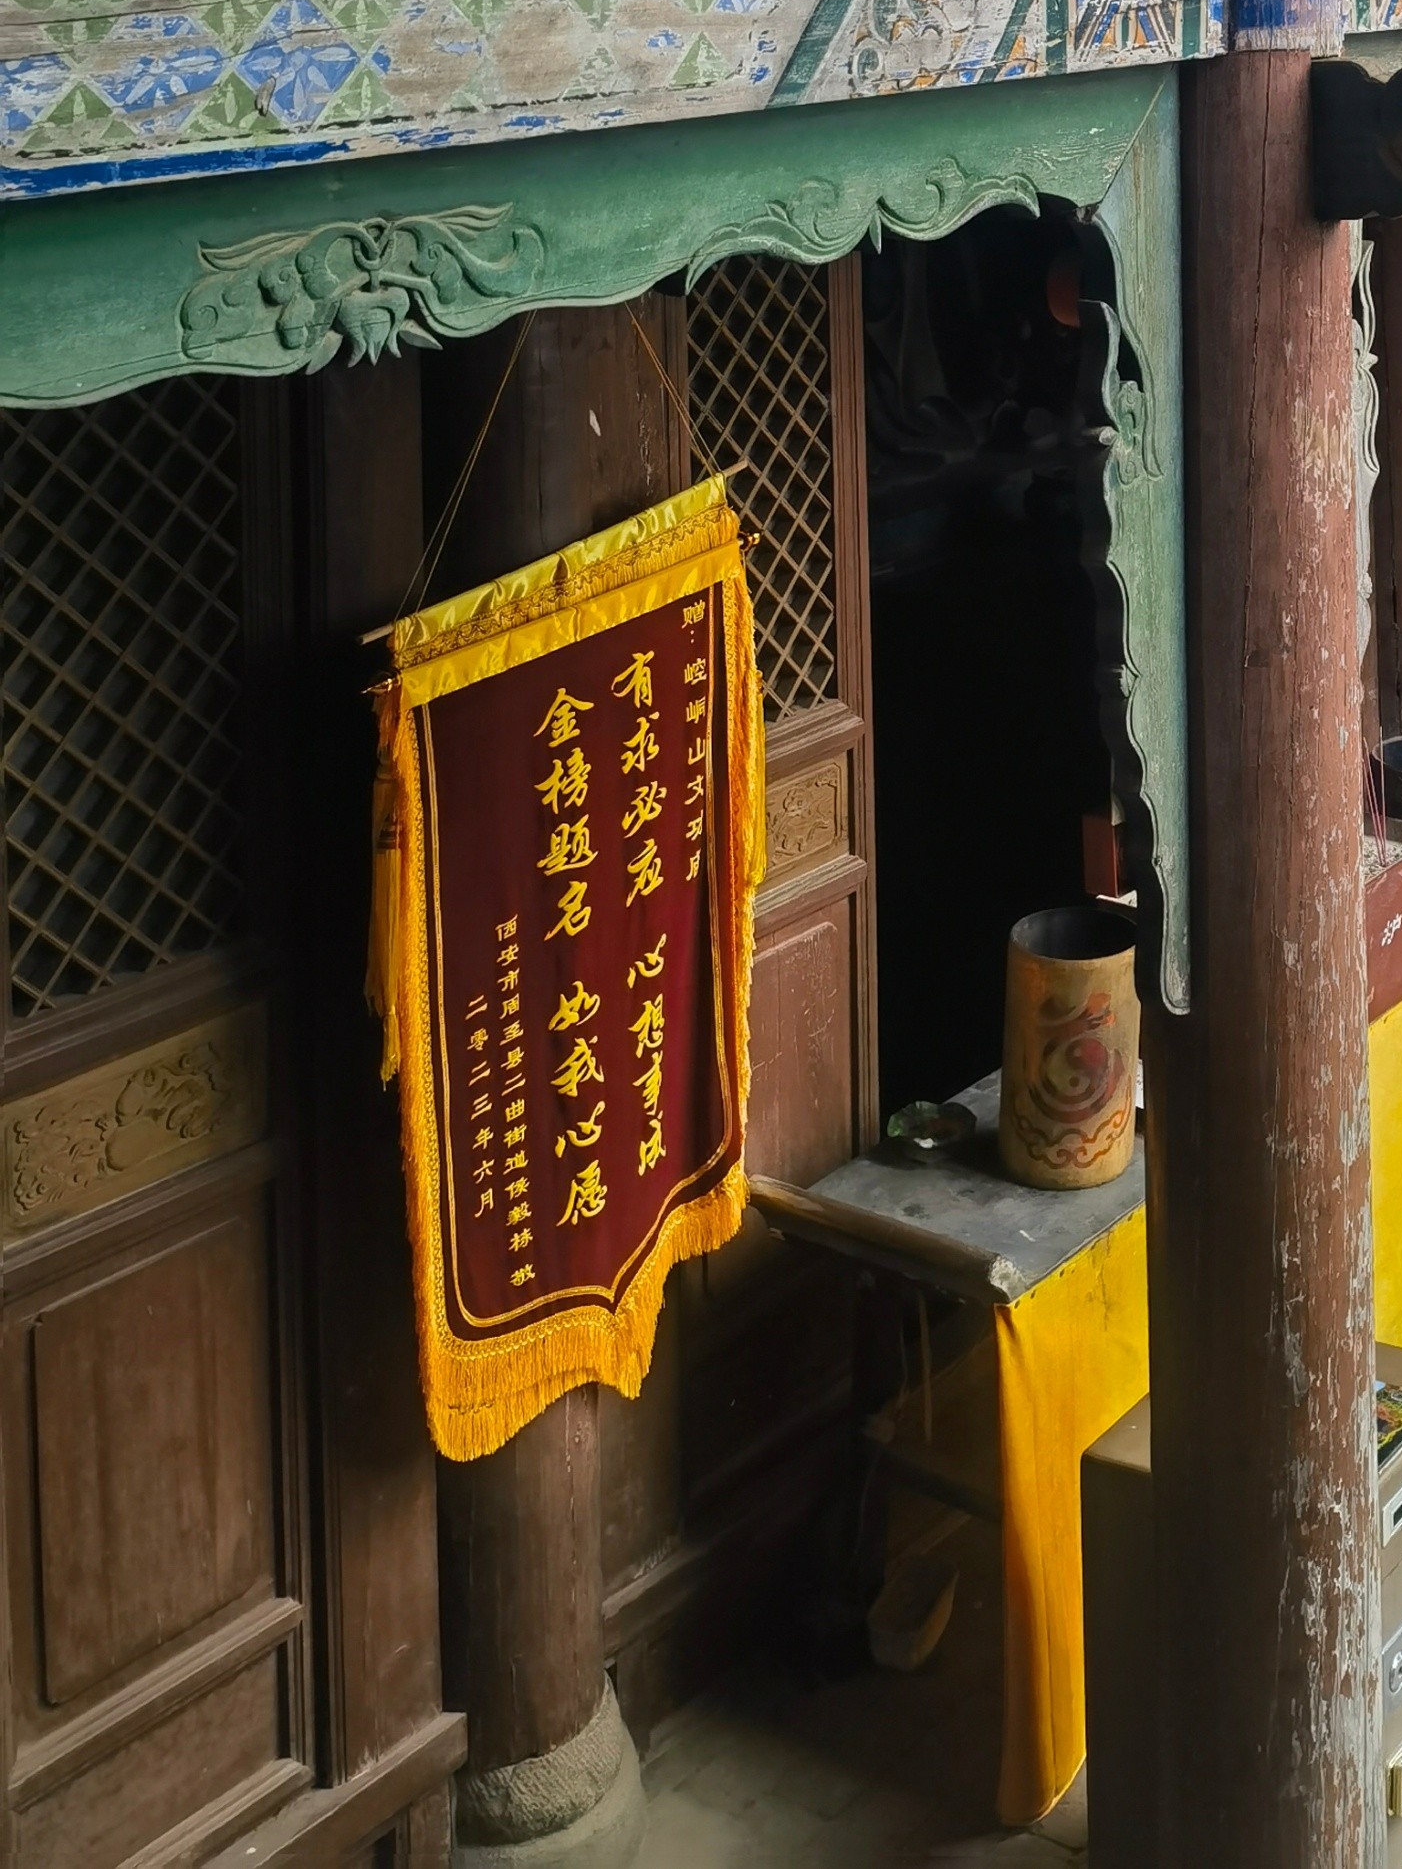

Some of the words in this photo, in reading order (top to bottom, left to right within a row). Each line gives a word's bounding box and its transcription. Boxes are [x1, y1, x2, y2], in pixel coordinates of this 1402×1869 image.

[533, 687, 600, 941] 金榜题名
[611, 650, 669, 908] 有求必应
[465, 994, 495, 1219] 二零二三年六月
[549, 980, 608, 1227] 如我心愿
[627, 933, 669, 1177] 心想事成
